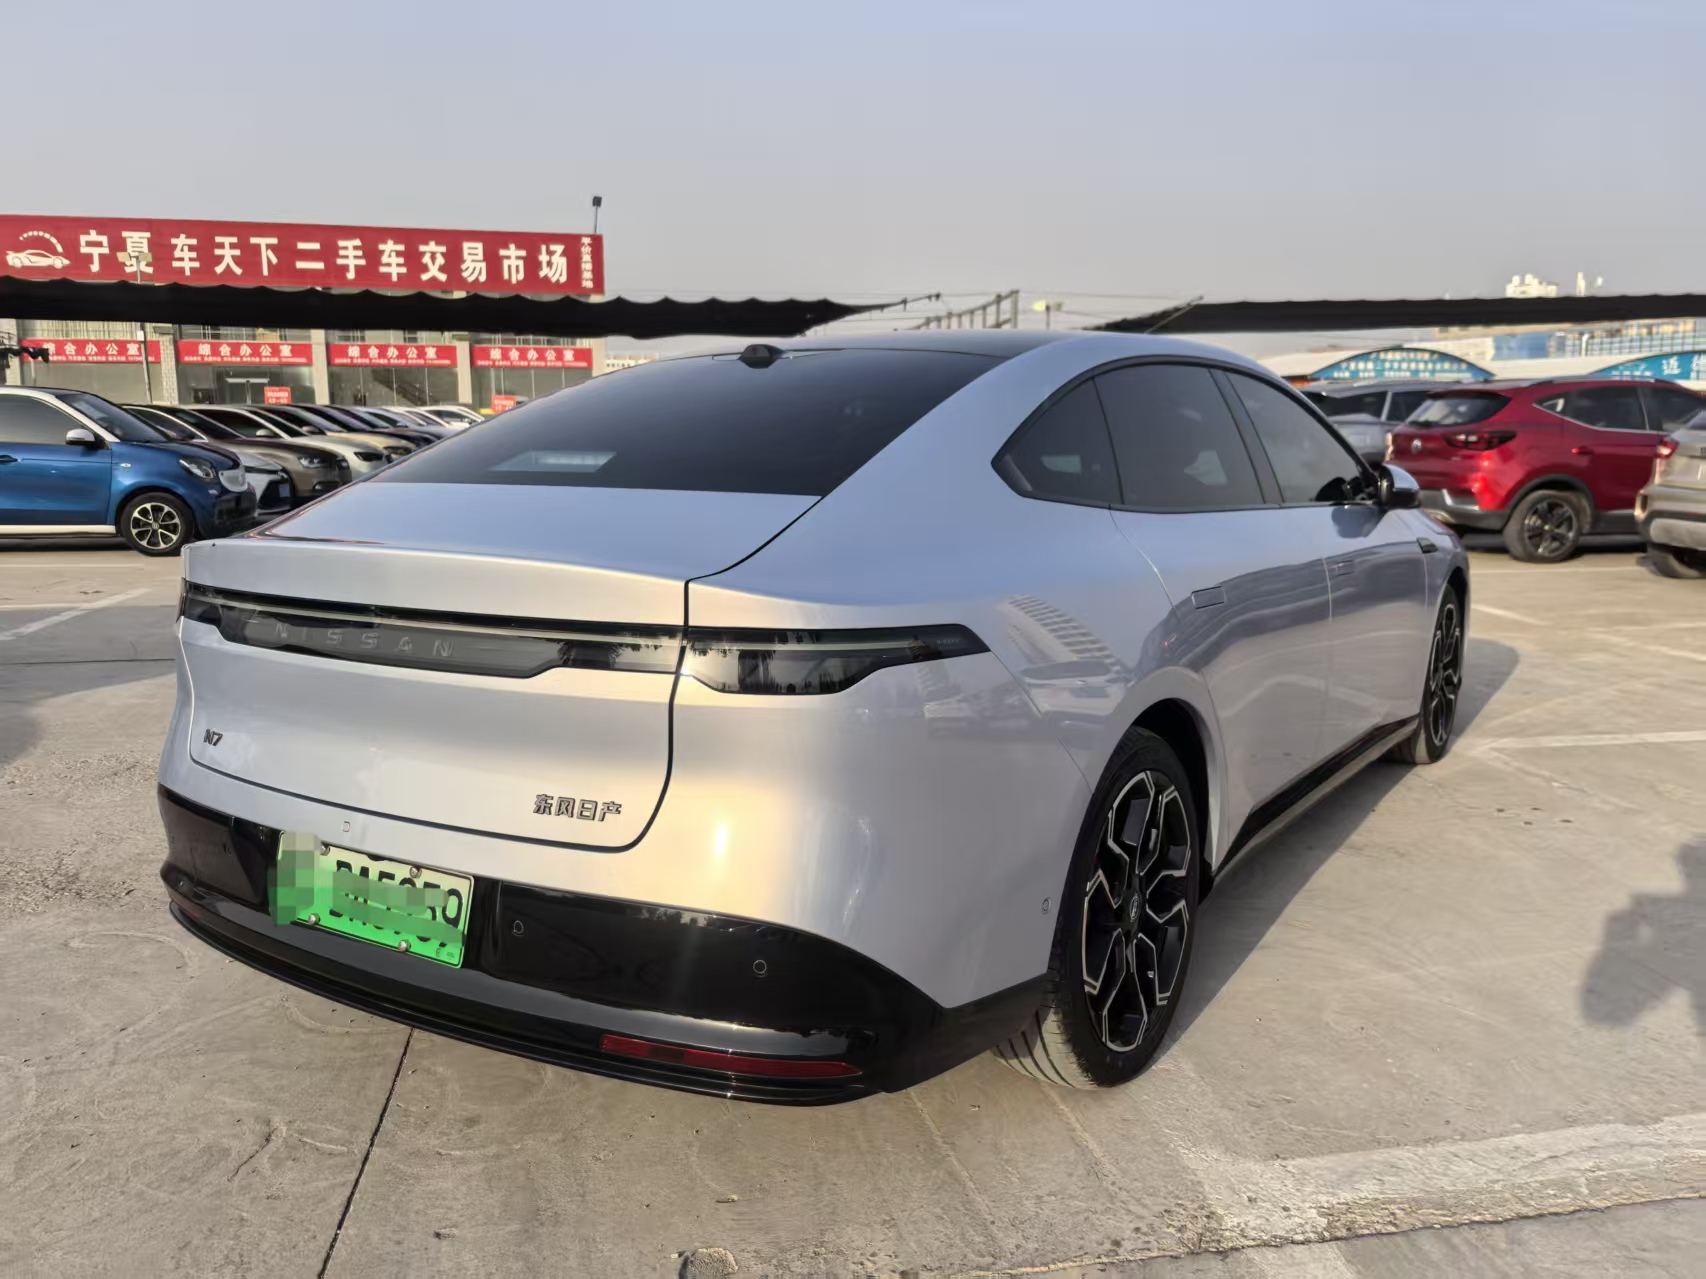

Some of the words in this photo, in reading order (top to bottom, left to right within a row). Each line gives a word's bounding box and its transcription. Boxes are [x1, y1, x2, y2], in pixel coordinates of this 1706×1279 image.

[80, 230, 567, 284] 宁夏车天下二手车交易市场
[198, 343, 292, 357] 综合办公室
[348, 345, 437, 359] 综合办公室
[275, 623, 455, 657] NISSAN
[204, 728, 223, 746] N7
[533, 794, 622, 822] 东风日产
